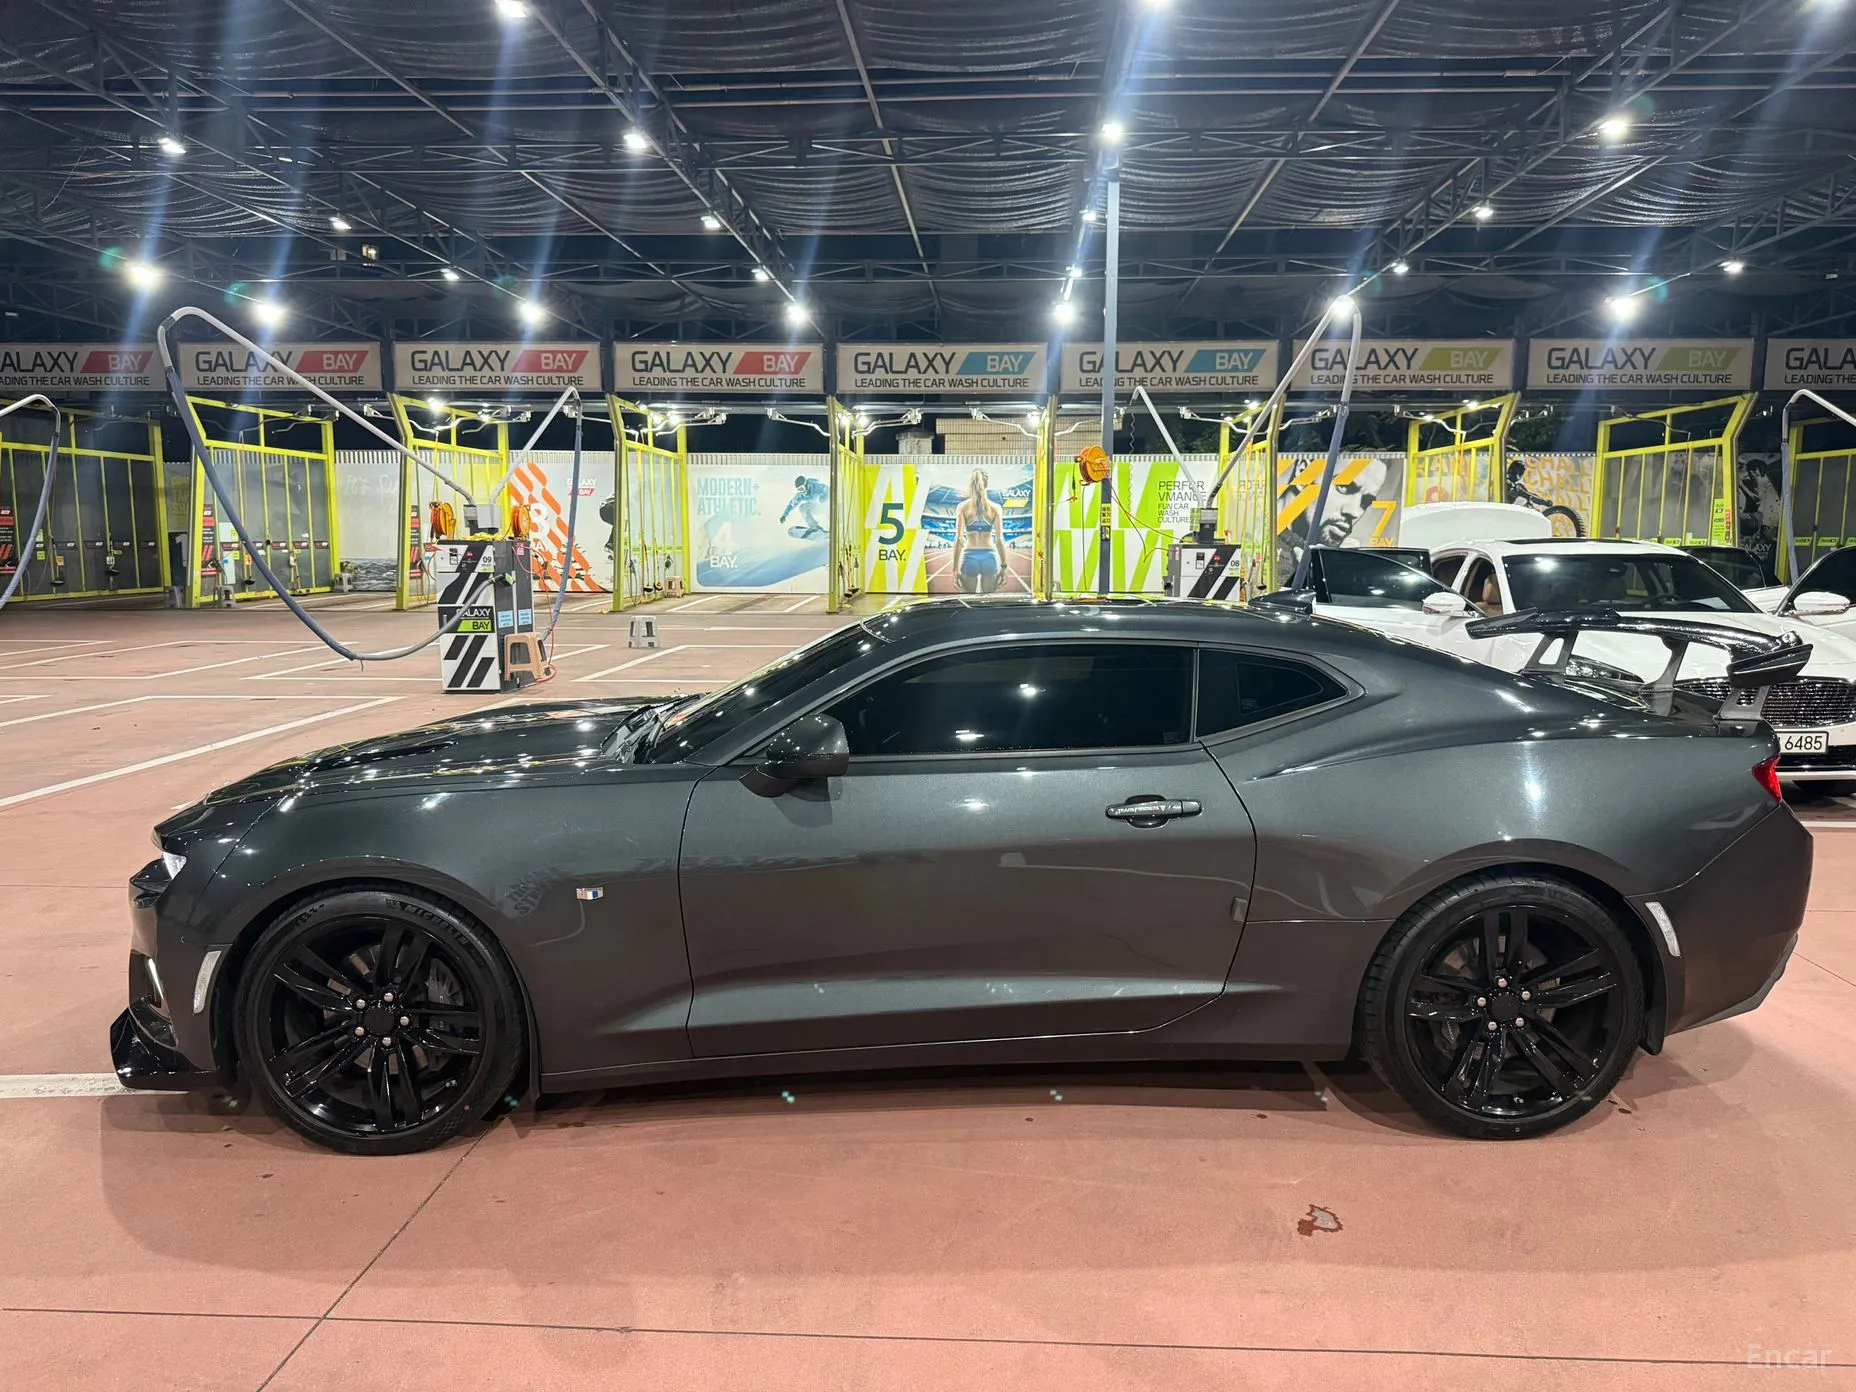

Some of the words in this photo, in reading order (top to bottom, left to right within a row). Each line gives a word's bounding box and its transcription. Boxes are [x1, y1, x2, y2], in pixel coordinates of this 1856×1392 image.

[0, 351, 78, 372] ALAXY
[108, 354, 142, 370] BAY
[323, 354, 356, 370] BAY
[411, 350, 510, 372] GALAXY
[541, 353, 576, 369] BAY
[631, 351, 732, 373] GALAXY
[763, 355, 798, 371] BAY
[854, 352, 956, 374] GALAXY
[987, 355, 1023, 372] BAY
[1216, 352, 1252, 369] BAY
[1450, 351, 1487, 368] BAY
[1547, 347, 1656, 370] GALAXY
[1688, 350, 1726, 367] BAY
[1785, 348, 1856, 370] GALA
[0, 376, 27, 385] ADING
[29, 376, 48, 385] THE
[51, 376, 70, 385] CAR
[74, 376, 102, 385] WASH
[105, 376, 149, 385] CULTURE
[198, 376, 240, 386] LEADING
[241, 376, 261, 386] THE
[264, 376, 284, 386] CAR
[287, 376, 316, 386] WH
[318, 376, 364, 386] CULTURE
[413, 376, 455, 385] LEADING
[457, 376, 477, 385] THE
[480, 376, 501, 385] CAR
[503, 376, 534, 385] WASH
[536, 376, 584, 385] CULTURE
[633, 377, 677, 387] LEADING
[679, 377, 699, 387] THE
[701, 377, 723, 387] CAR
[725, 377, 756, 387] WASH
[758, 377, 805, 387] CULTURE
[855, 378, 899, 388] LEADING
[901, 378, 921, 388] THE
[924, 378, 945, 388] CAR
[948, 378, 978, 388] WASH
[981, 378, 1029, 388] CULTURE
[1080, 376, 1125, 387] LEAG
[1127, 376, 1147, 387] THE
[1150, 376, 1172, 387] CAR
[1175, 376, 1206, 387] WASH
[1209, 376, 1259, 387] CULTURE
[1360, 374, 1380, 384] THE
[1383, 374, 1406, 384] CAR
[1409, 374, 1441, 384] WASH
[1443, 374, 1493, 384] CULTURE
[1547, 374, 1594, 383] LEADING
[1596, 374, 1618, 383] THE
[1620, 374, 1643, 383] CAR
[1646, 374, 1678, 383] WASH
[1681, 374, 1731, 383] CULTURE
[1785, 374, 1832, 384] LEADING
[1835, 374, 1856, 384] THE
[1002, 489, 1031, 497] GALAXY
[878, 502, 905, 545] 5
[1371, 500, 1397, 537] 7
[1742, 543, 1772, 552] ALAXY
[878, 549, 906, 561] BAY.
[710, 555, 738, 569] BAY.
[472, 621, 490, 630] BAY
[1785, 736, 1823, 751] 6485
